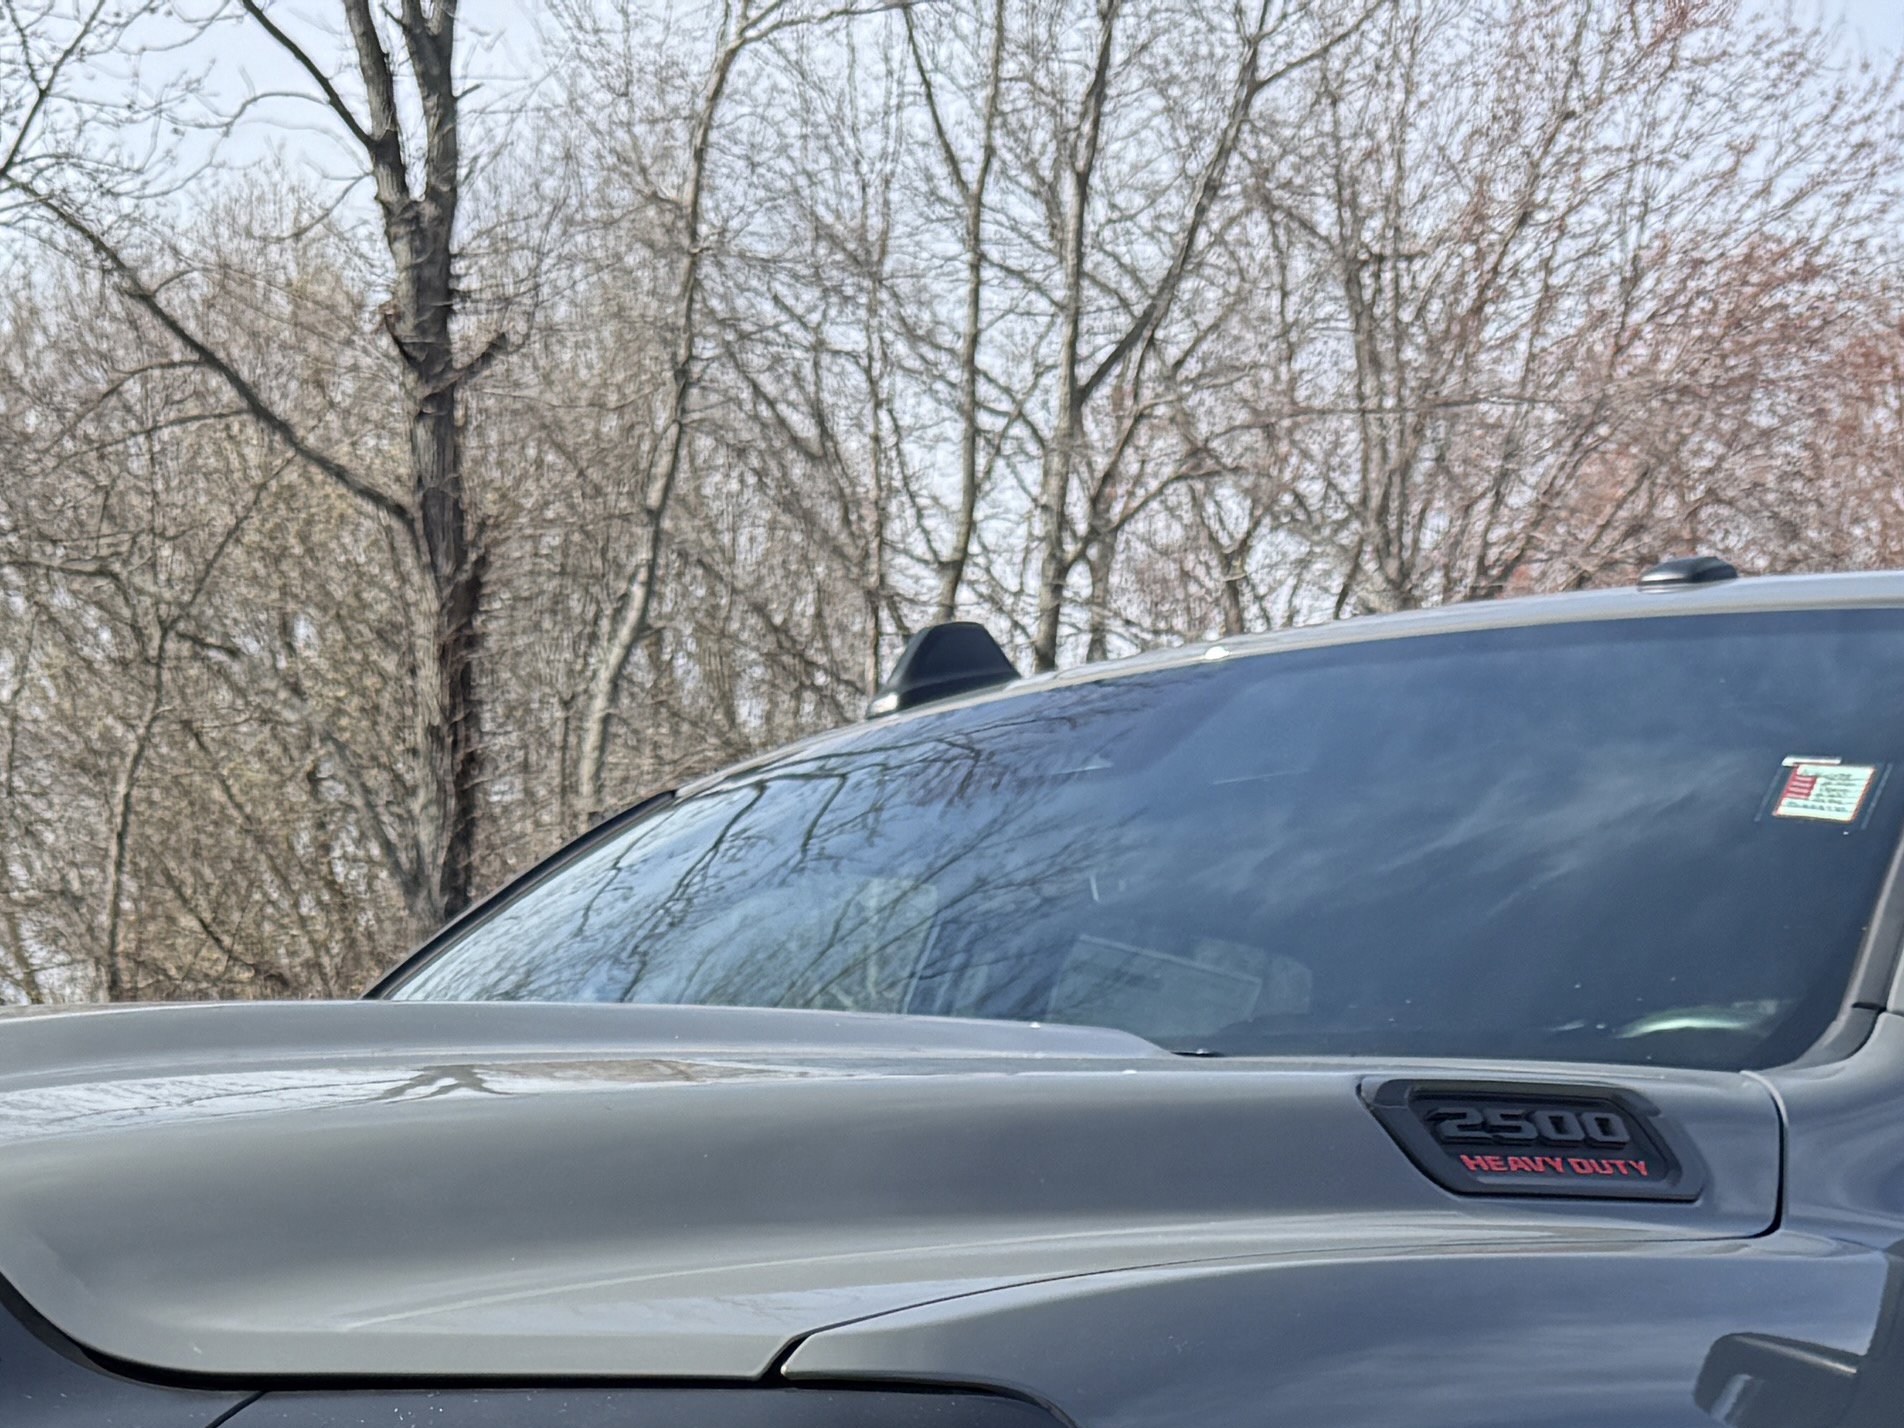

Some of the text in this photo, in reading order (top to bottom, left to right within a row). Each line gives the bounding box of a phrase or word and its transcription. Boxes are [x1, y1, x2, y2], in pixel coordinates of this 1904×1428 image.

[1425, 1107, 1630, 1148] 2500
[1460, 1154, 1648, 1177] HEAVY DUTY
